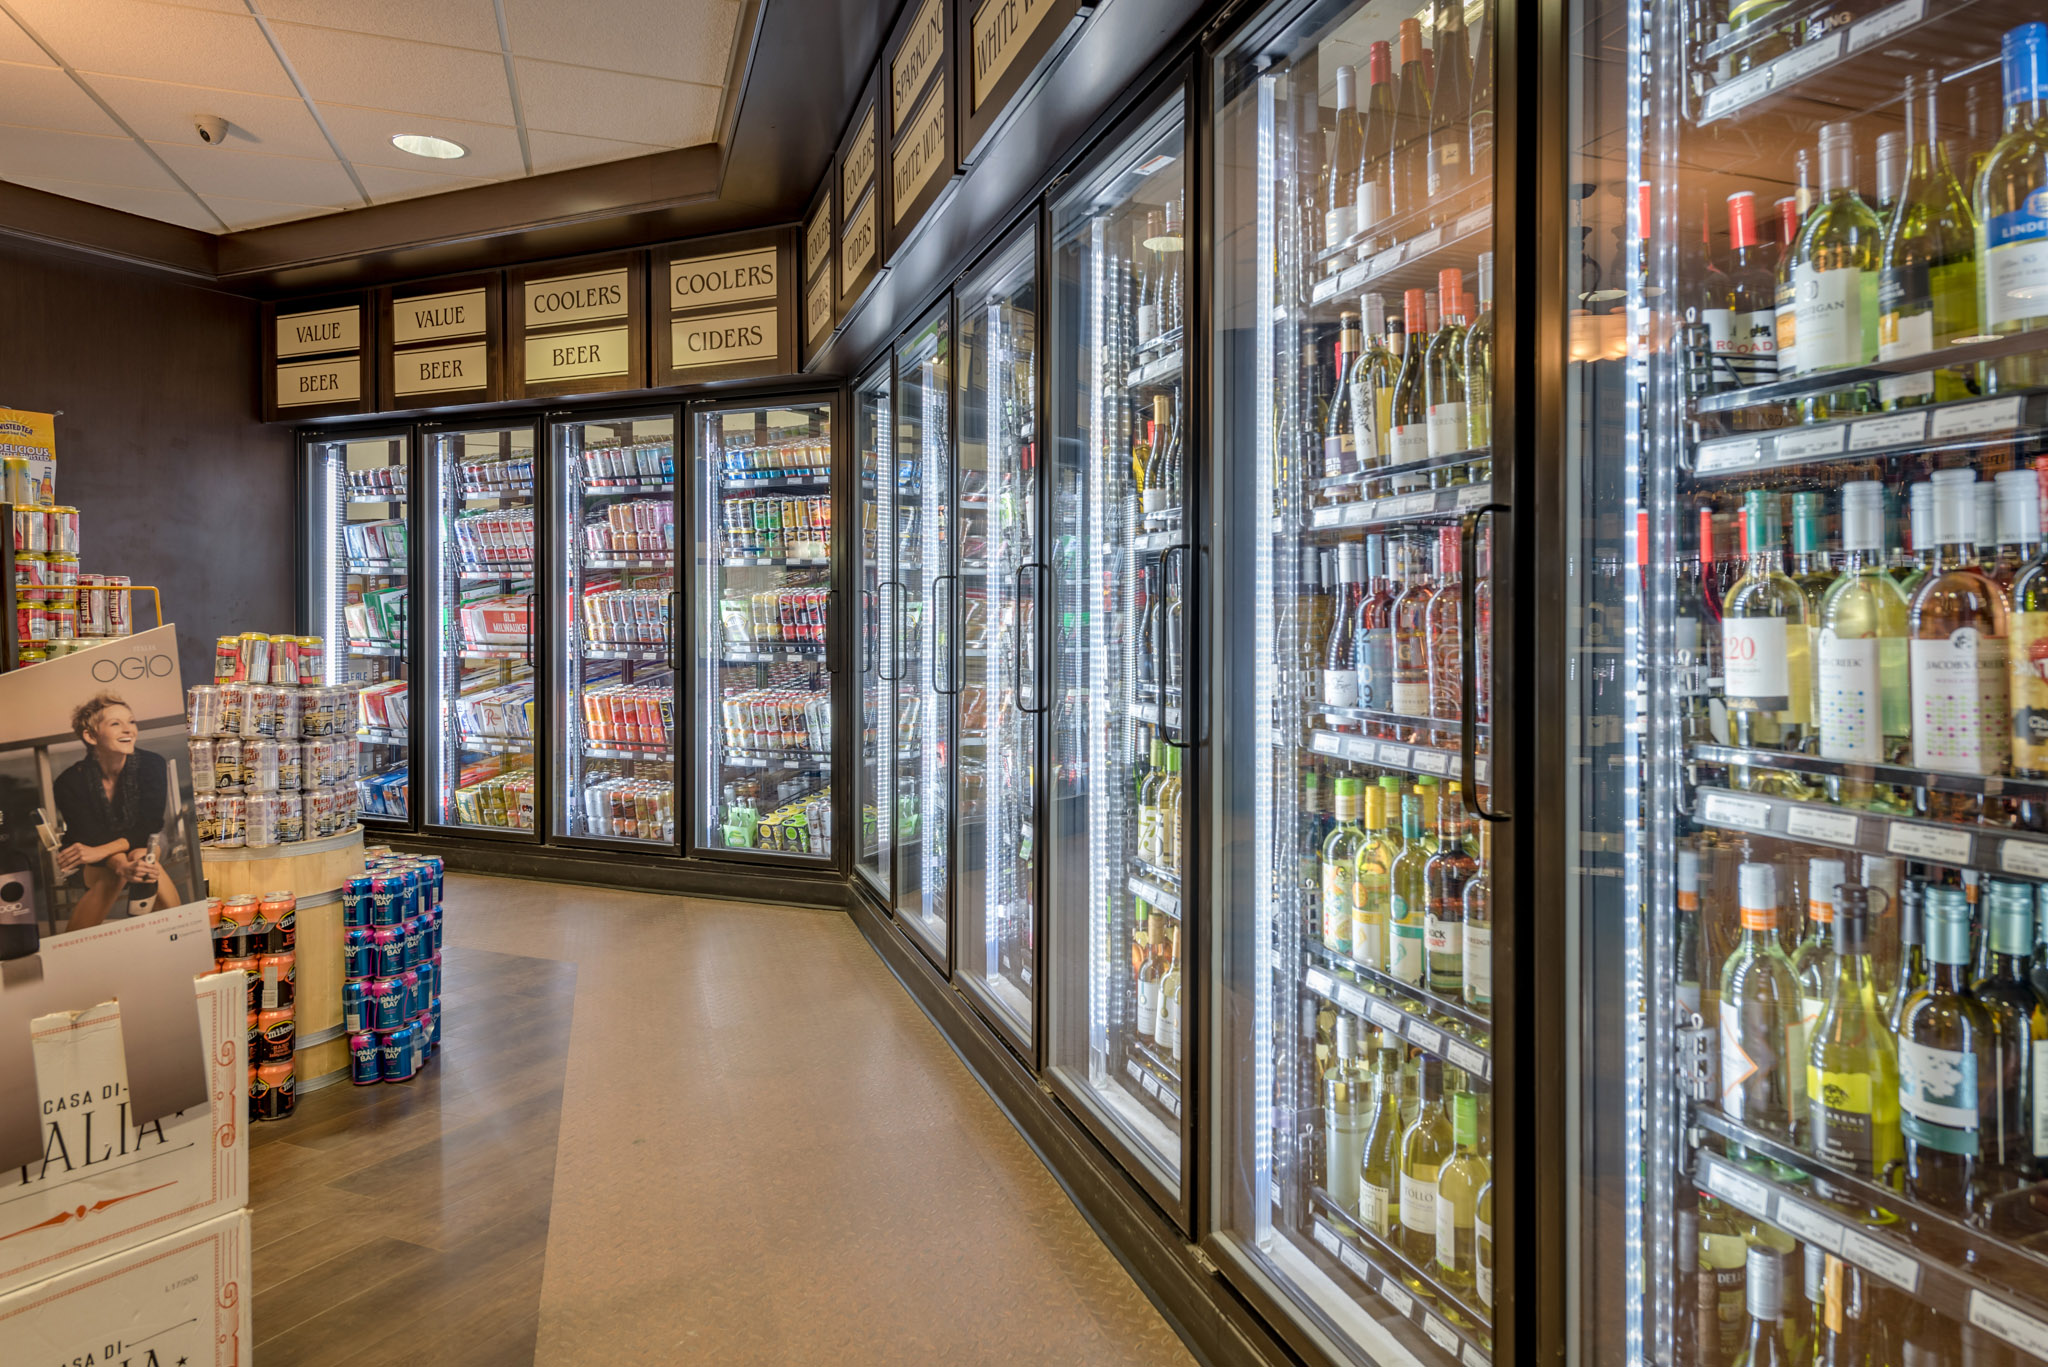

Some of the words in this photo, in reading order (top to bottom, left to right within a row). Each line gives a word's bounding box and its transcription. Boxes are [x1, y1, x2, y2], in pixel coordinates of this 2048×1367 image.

[977, 0, 1019, 80] WHITE
[895, 1, 943, 111] SPARKLING
[845, 129, 875, 202] COOLERS
[895, 143, 921, 202] WHITE
[922, 106, 944, 164] WINE
[808, 212, 831, 265] COOLERS
[2002, 220, 2048, 238] LINDE
[847, 217, 872, 272] CIDERS
[676, 264, 774, 296] COOLERS
[534, 284, 621, 314] COOLERS
[415, 306, 465, 328] VALUE
[296, 322, 341, 343] VALUE
[687, 325, 763, 352] CIDERS
[552, 344, 601, 367] BEER
[419, 360, 463, 380] BEER
[299, 373, 338, 393] BEER
[21, 425, 34, 436] TEA
[503, 612, 516, 622] OLD
[1724, 636, 1756, 661] 120
[92, 654, 173, 683] OGIO
[384, 942, 404, 951] PALM
[381, 994, 401, 1004] PALM
[357, 1047, 377, 1056] PALM
[385, 1052, 399, 1060] BAY
[43, 1090, 92, 1115] CASA
[104, 1340, 122, 1360] DI
